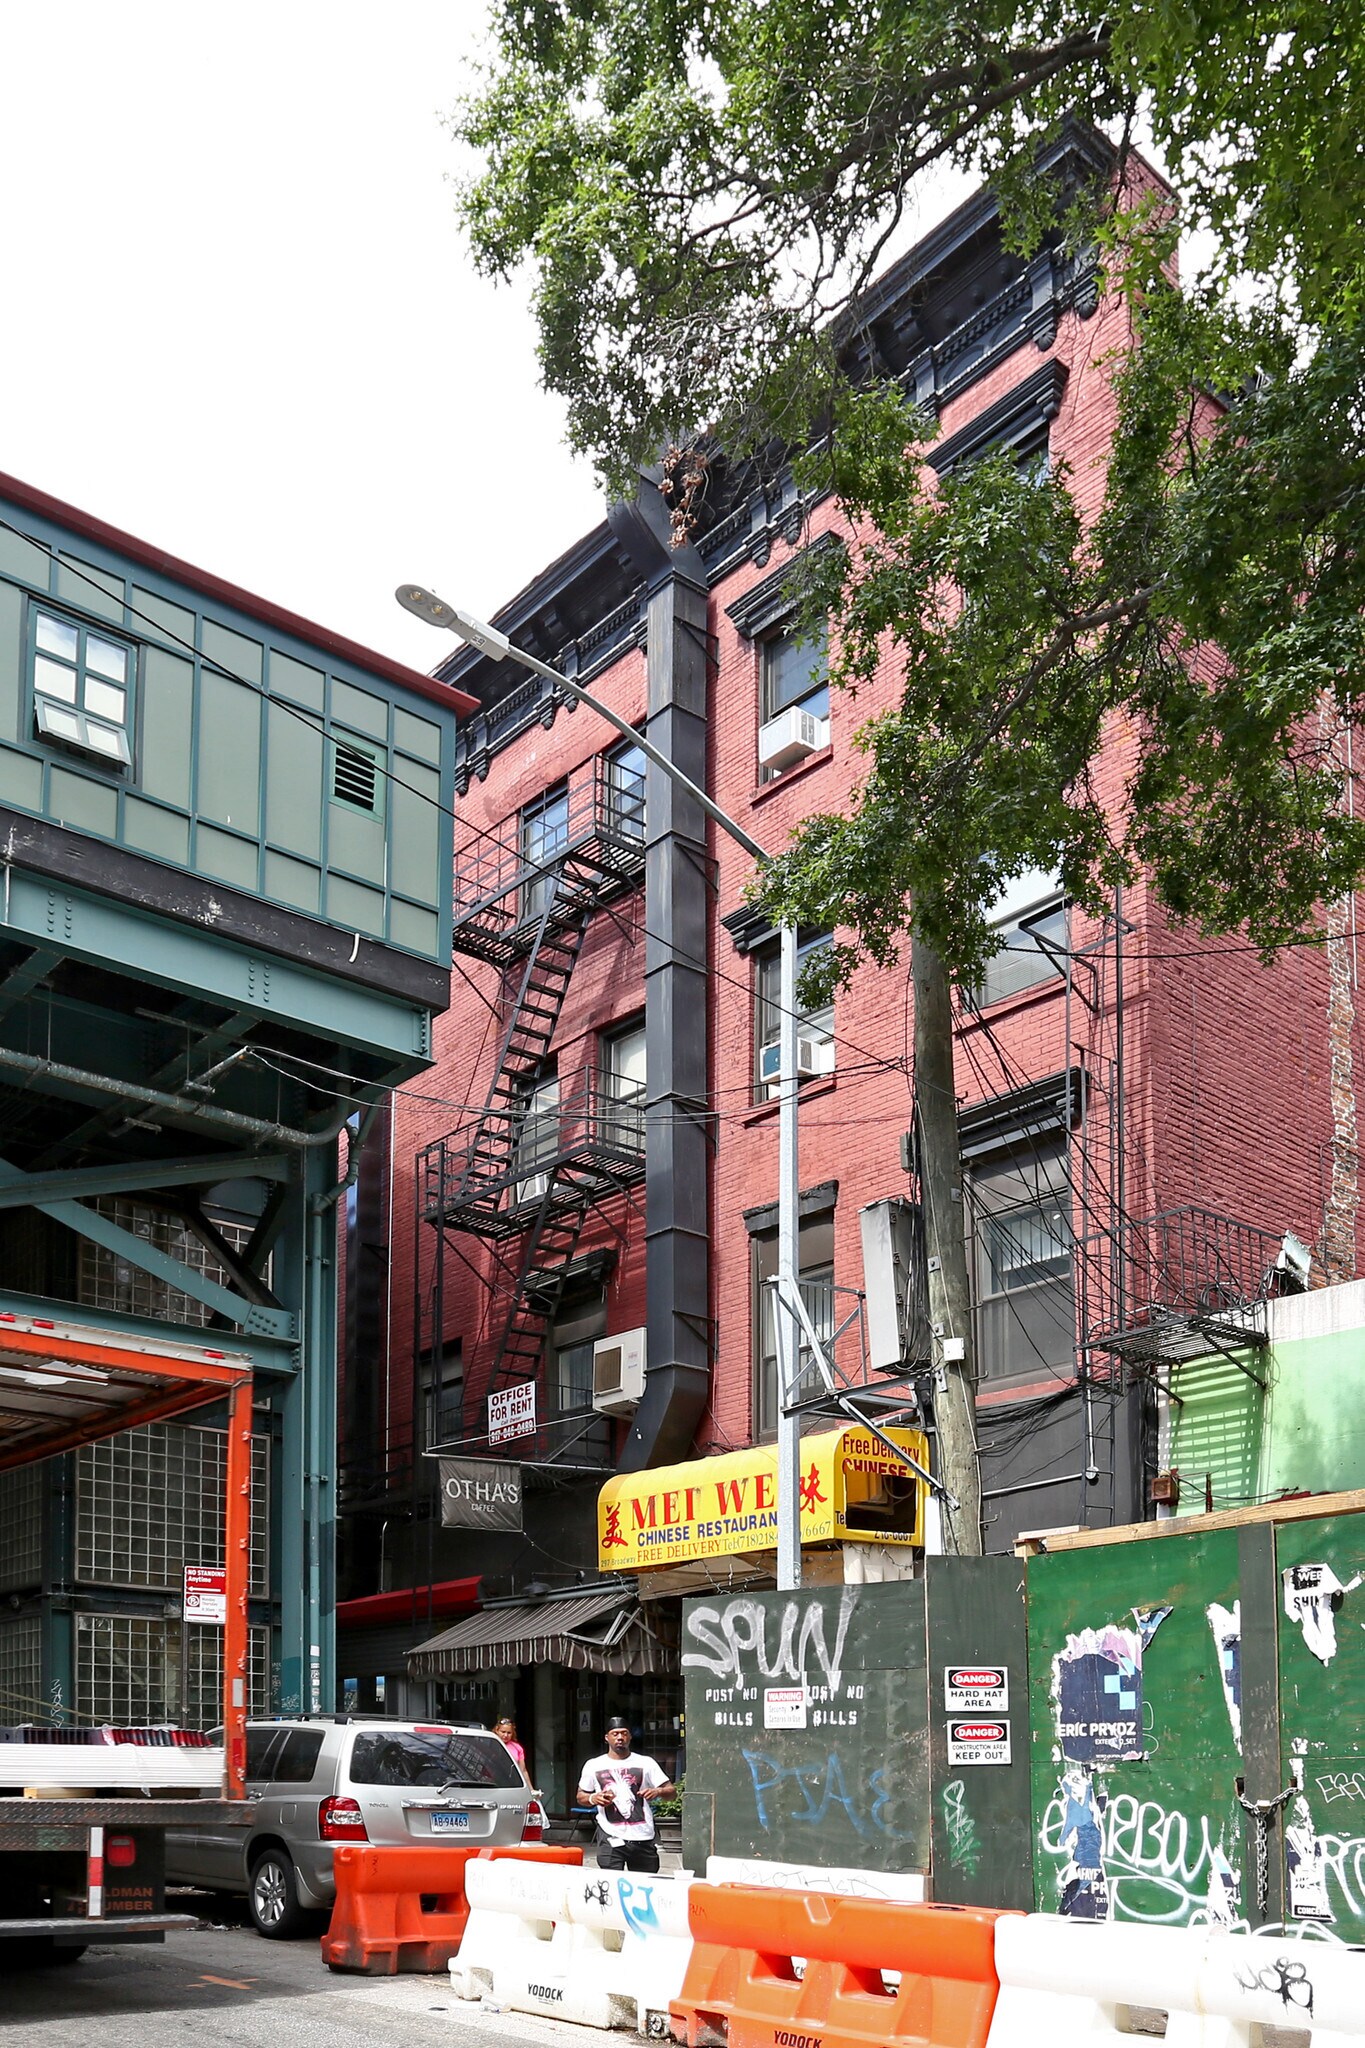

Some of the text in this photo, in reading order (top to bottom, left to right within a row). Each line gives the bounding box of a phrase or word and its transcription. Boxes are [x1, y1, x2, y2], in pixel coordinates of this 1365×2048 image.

[491, 1384, 531, 1407] OFFICE
[490, 1397, 532, 1422] FOR RENT
[842, 1433, 919, 1464] Free Deery
[445, 1477, 519, 1504] OTHA'S
[471, 1503, 495, 1513] COFFEE
[631, 1473, 777, 1531] MEI WE
[602, 1502, 629, 1549] 美
[637, 1511, 777, 1547] CHINESE RESTAURAN
[637, 1546, 664, 1562] FREE
[667, 1539, 720, 1558] DELIVERY
[600, 1557, 636, 1568] 297 Broadway
[955, 1675, 997, 1683] DANGER
[705, 1687, 758, 1702] POST NO
[768, 1692, 803, 1701] WARNING
[846, 1685, 865, 1700] NO
[581, 1713, 588, 1726] A
[714, 1711, 754, 1727] BILLS
[812, 1709, 858, 1727] BILLS
[958, 1728, 1000, 1737] DANGER
[1060, 1721, 1137, 1737] ERIC PRYDZ
[955, 1751, 1004, 1759] KEEP OUT
[528, 1983, 563, 2001] YODOCK
[774, 2030, 822, 2048] YODOCK
